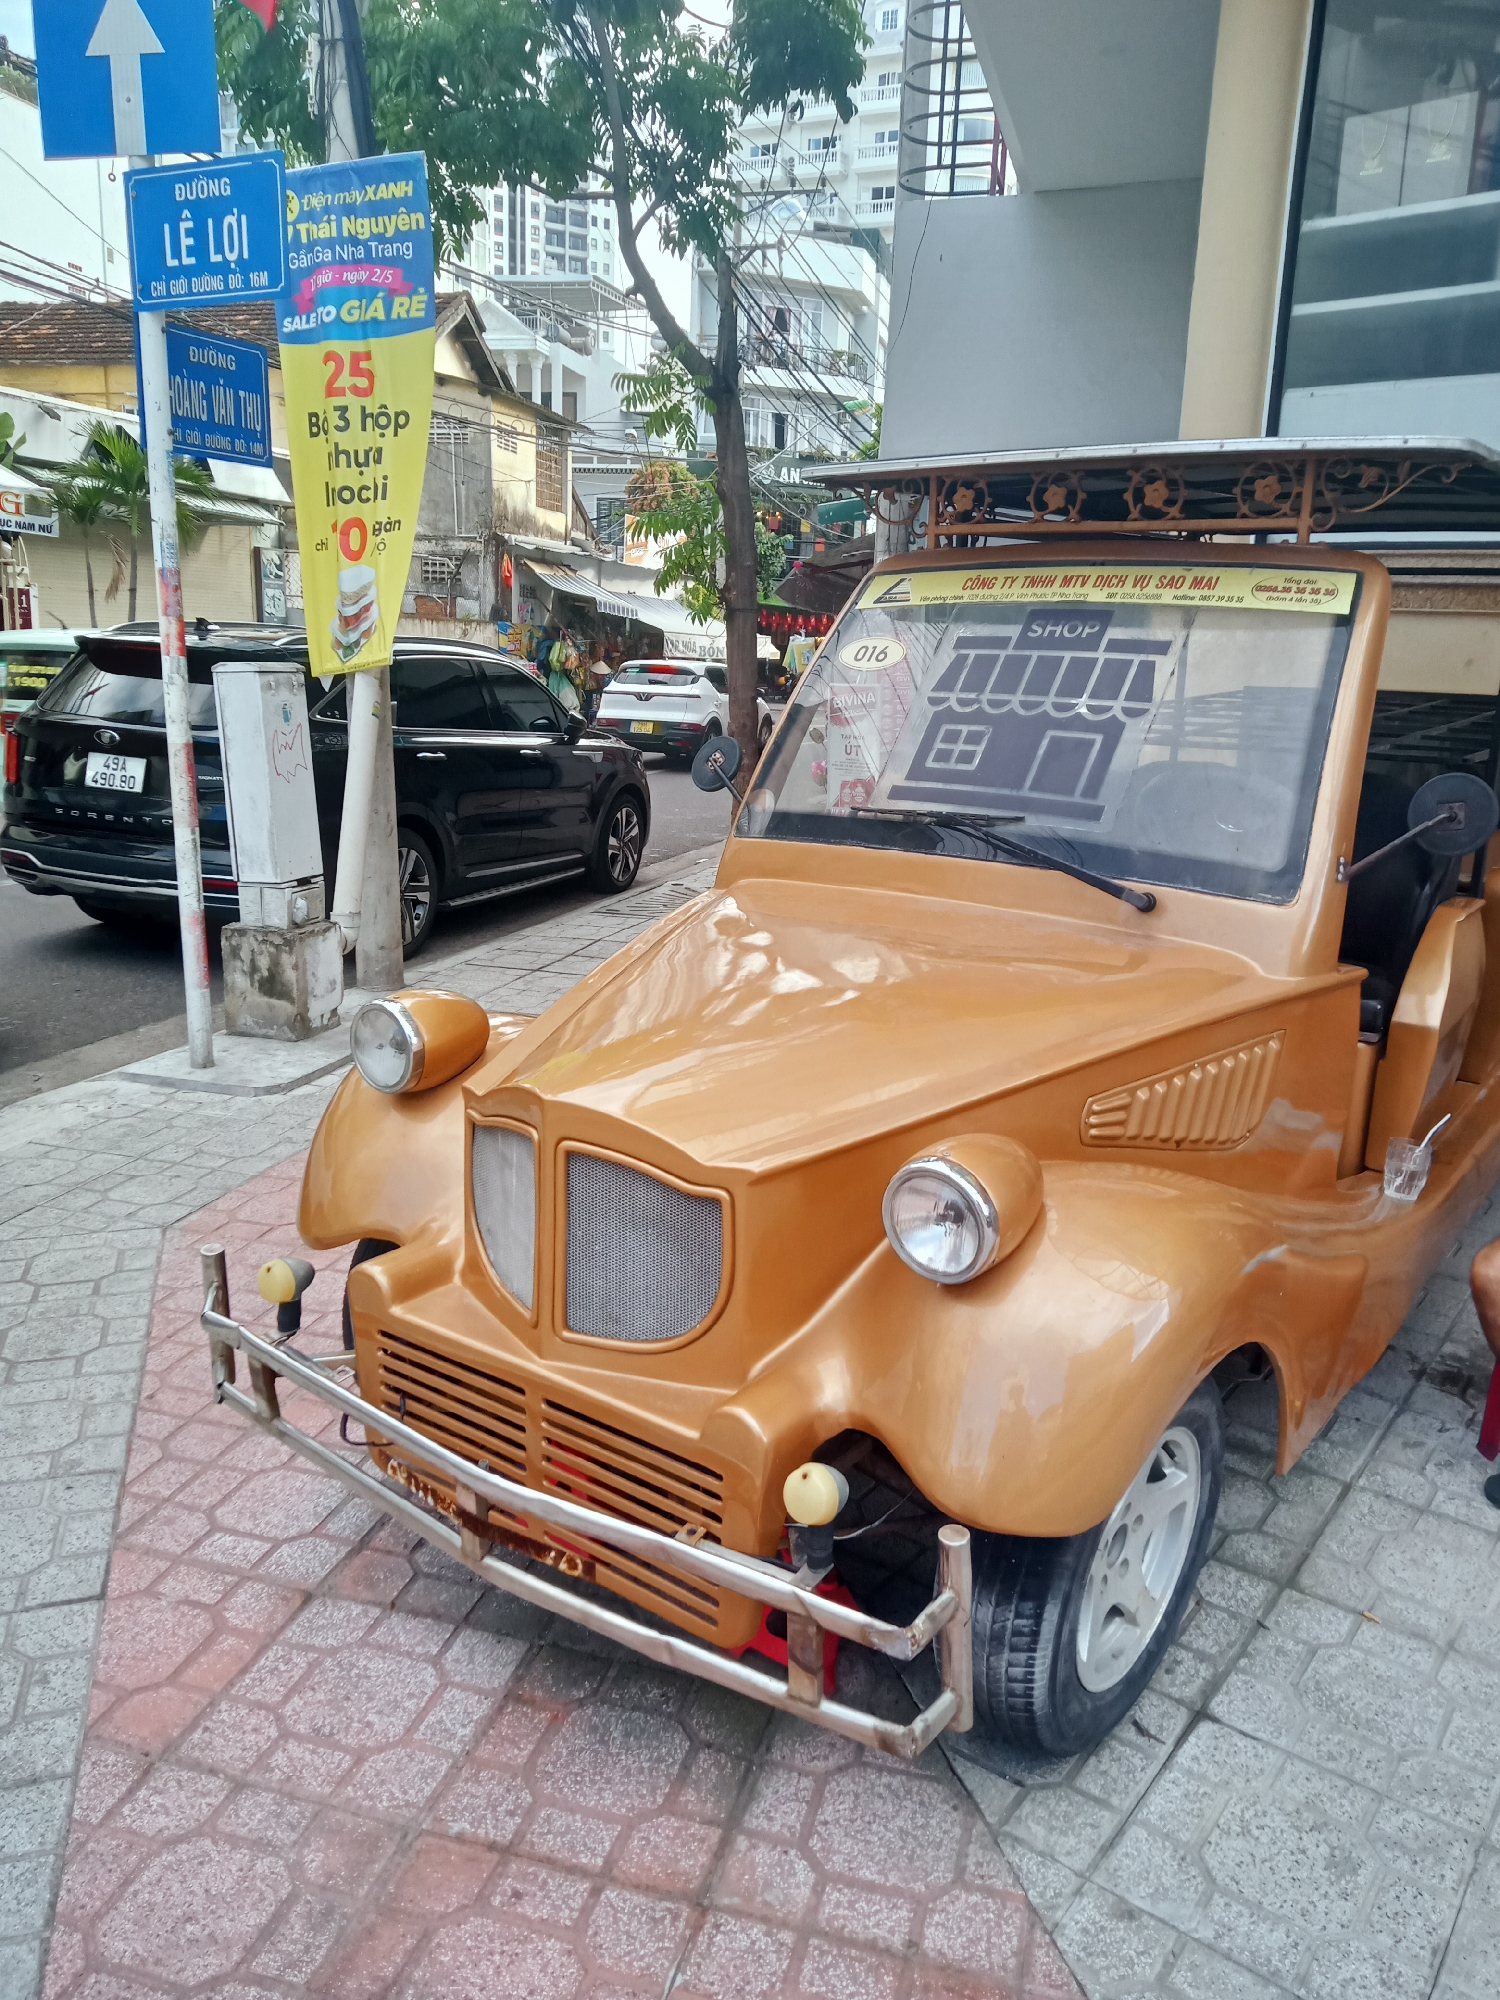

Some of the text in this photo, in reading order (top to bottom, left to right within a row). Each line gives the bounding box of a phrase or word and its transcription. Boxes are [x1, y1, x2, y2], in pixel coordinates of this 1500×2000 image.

[174, 175, 231, 201] ĐƯỜNG
[364, 180, 413, 202] XANH
[296, 207, 425, 244] Thái Nguyên
[163, 208, 249, 268] LÊ LỢI
[335, 243, 364, 261] Nha
[368, 241, 413, 260] Trang
[151, 268, 268, 297] CHỈ GIỚI ĐƯỜNG ĐỎ: 16M
[316, 270, 333, 288] giờ
[342, 267, 369, 284] ngày
[371, 268, 394, 284] 2/5
[339, 291, 386, 323] GIÁ
[391, 287, 428, 320] RẺ
[189, 345, 236, 371] ĐƯỜNG
[322, 350, 375, 399] 25
[212, 377, 235, 426] VĂN
[238, 390, 262, 439] THỤ
[307, 404, 410, 444] Bộ 3 hộp
[171, 423, 182, 442] HỈ
[205, 431, 231, 450] ĐƯỜNG
[15, 520, 35, 531] NAM
[315, 537, 329, 552] chỉ
[962, 574, 1220, 592] CÔNG TY TNHH MTV DỊCH VỤ SAO MAI
[1027, 620, 1101, 638] SHOP
[853, 645, 889, 662] 016
[833, 692, 876, 708] BIVINA
[845, 741, 861, 756] ÚT
[103, 756, 127, 773] 49A
